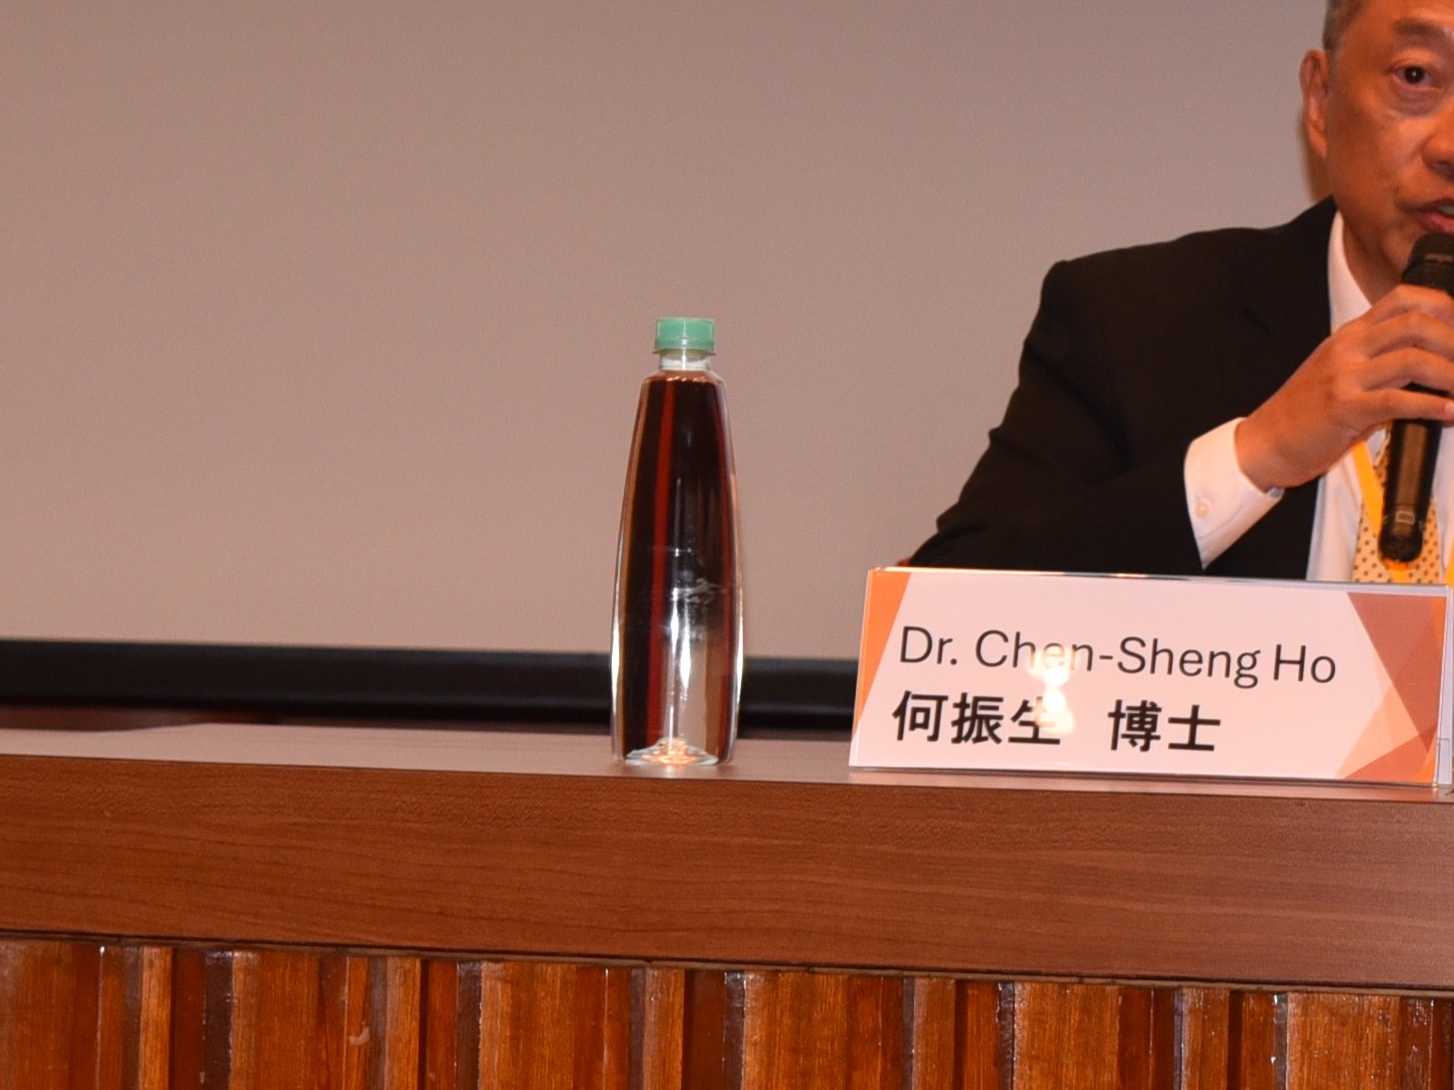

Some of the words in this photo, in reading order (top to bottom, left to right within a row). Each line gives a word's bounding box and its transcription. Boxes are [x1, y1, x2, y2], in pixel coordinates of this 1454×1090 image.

[899, 625, 958, 666] Dr.
[975, 629, 1261, 689] Chen-Sheng
[1273, 643, 1337, 684] Ho
[891, 690, 1062, 746] 何振生
[1107, 699, 1222, 753] 博士
